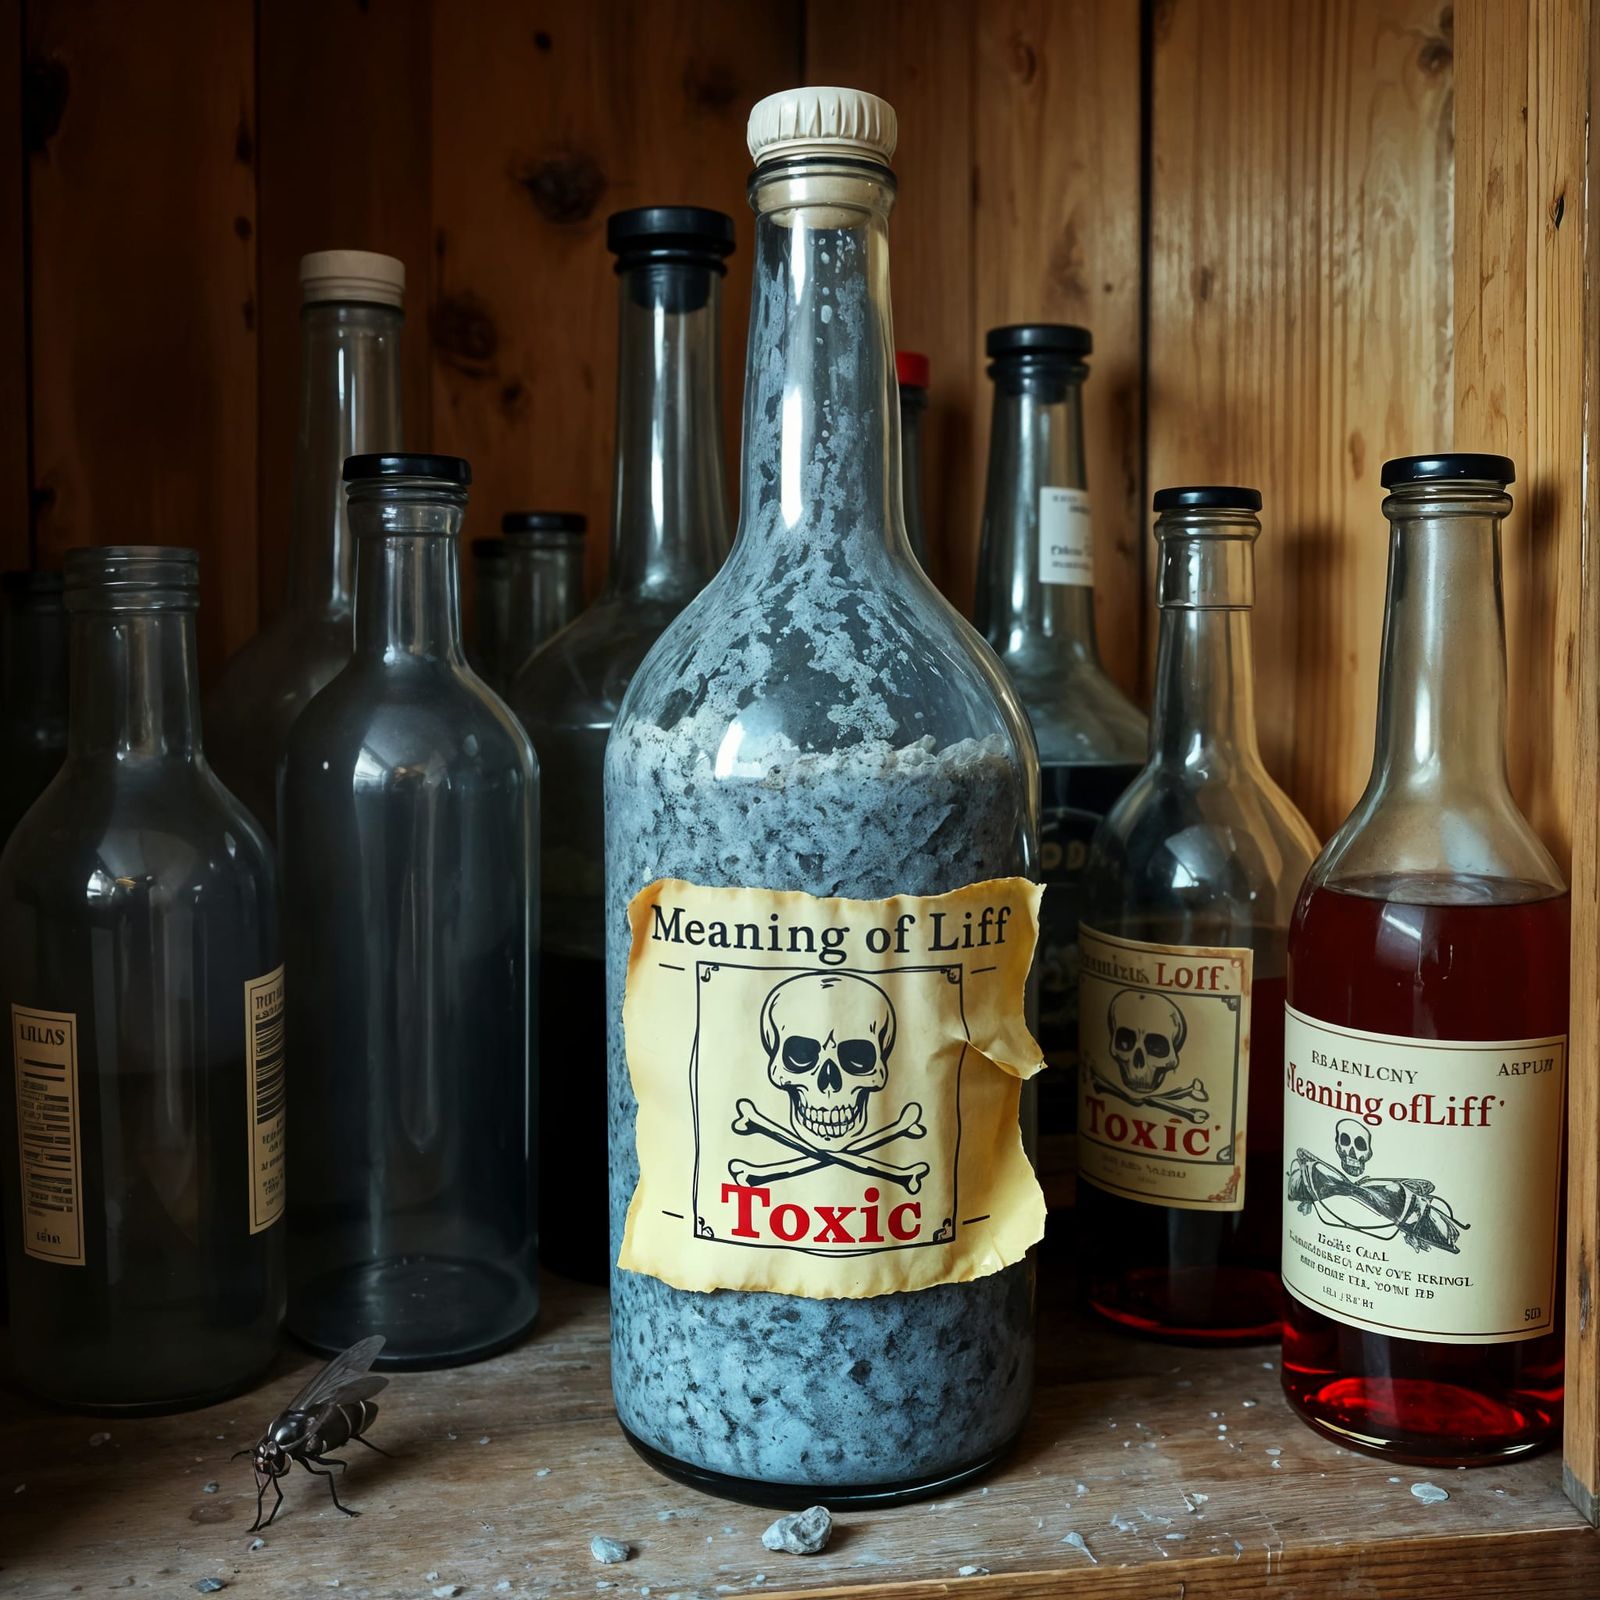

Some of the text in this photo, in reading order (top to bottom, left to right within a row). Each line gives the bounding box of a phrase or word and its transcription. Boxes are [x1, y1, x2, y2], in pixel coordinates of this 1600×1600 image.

[651, 904, 1012, 965] Meaning of Liff
[720, 1182, 922, 1244] Toxic
